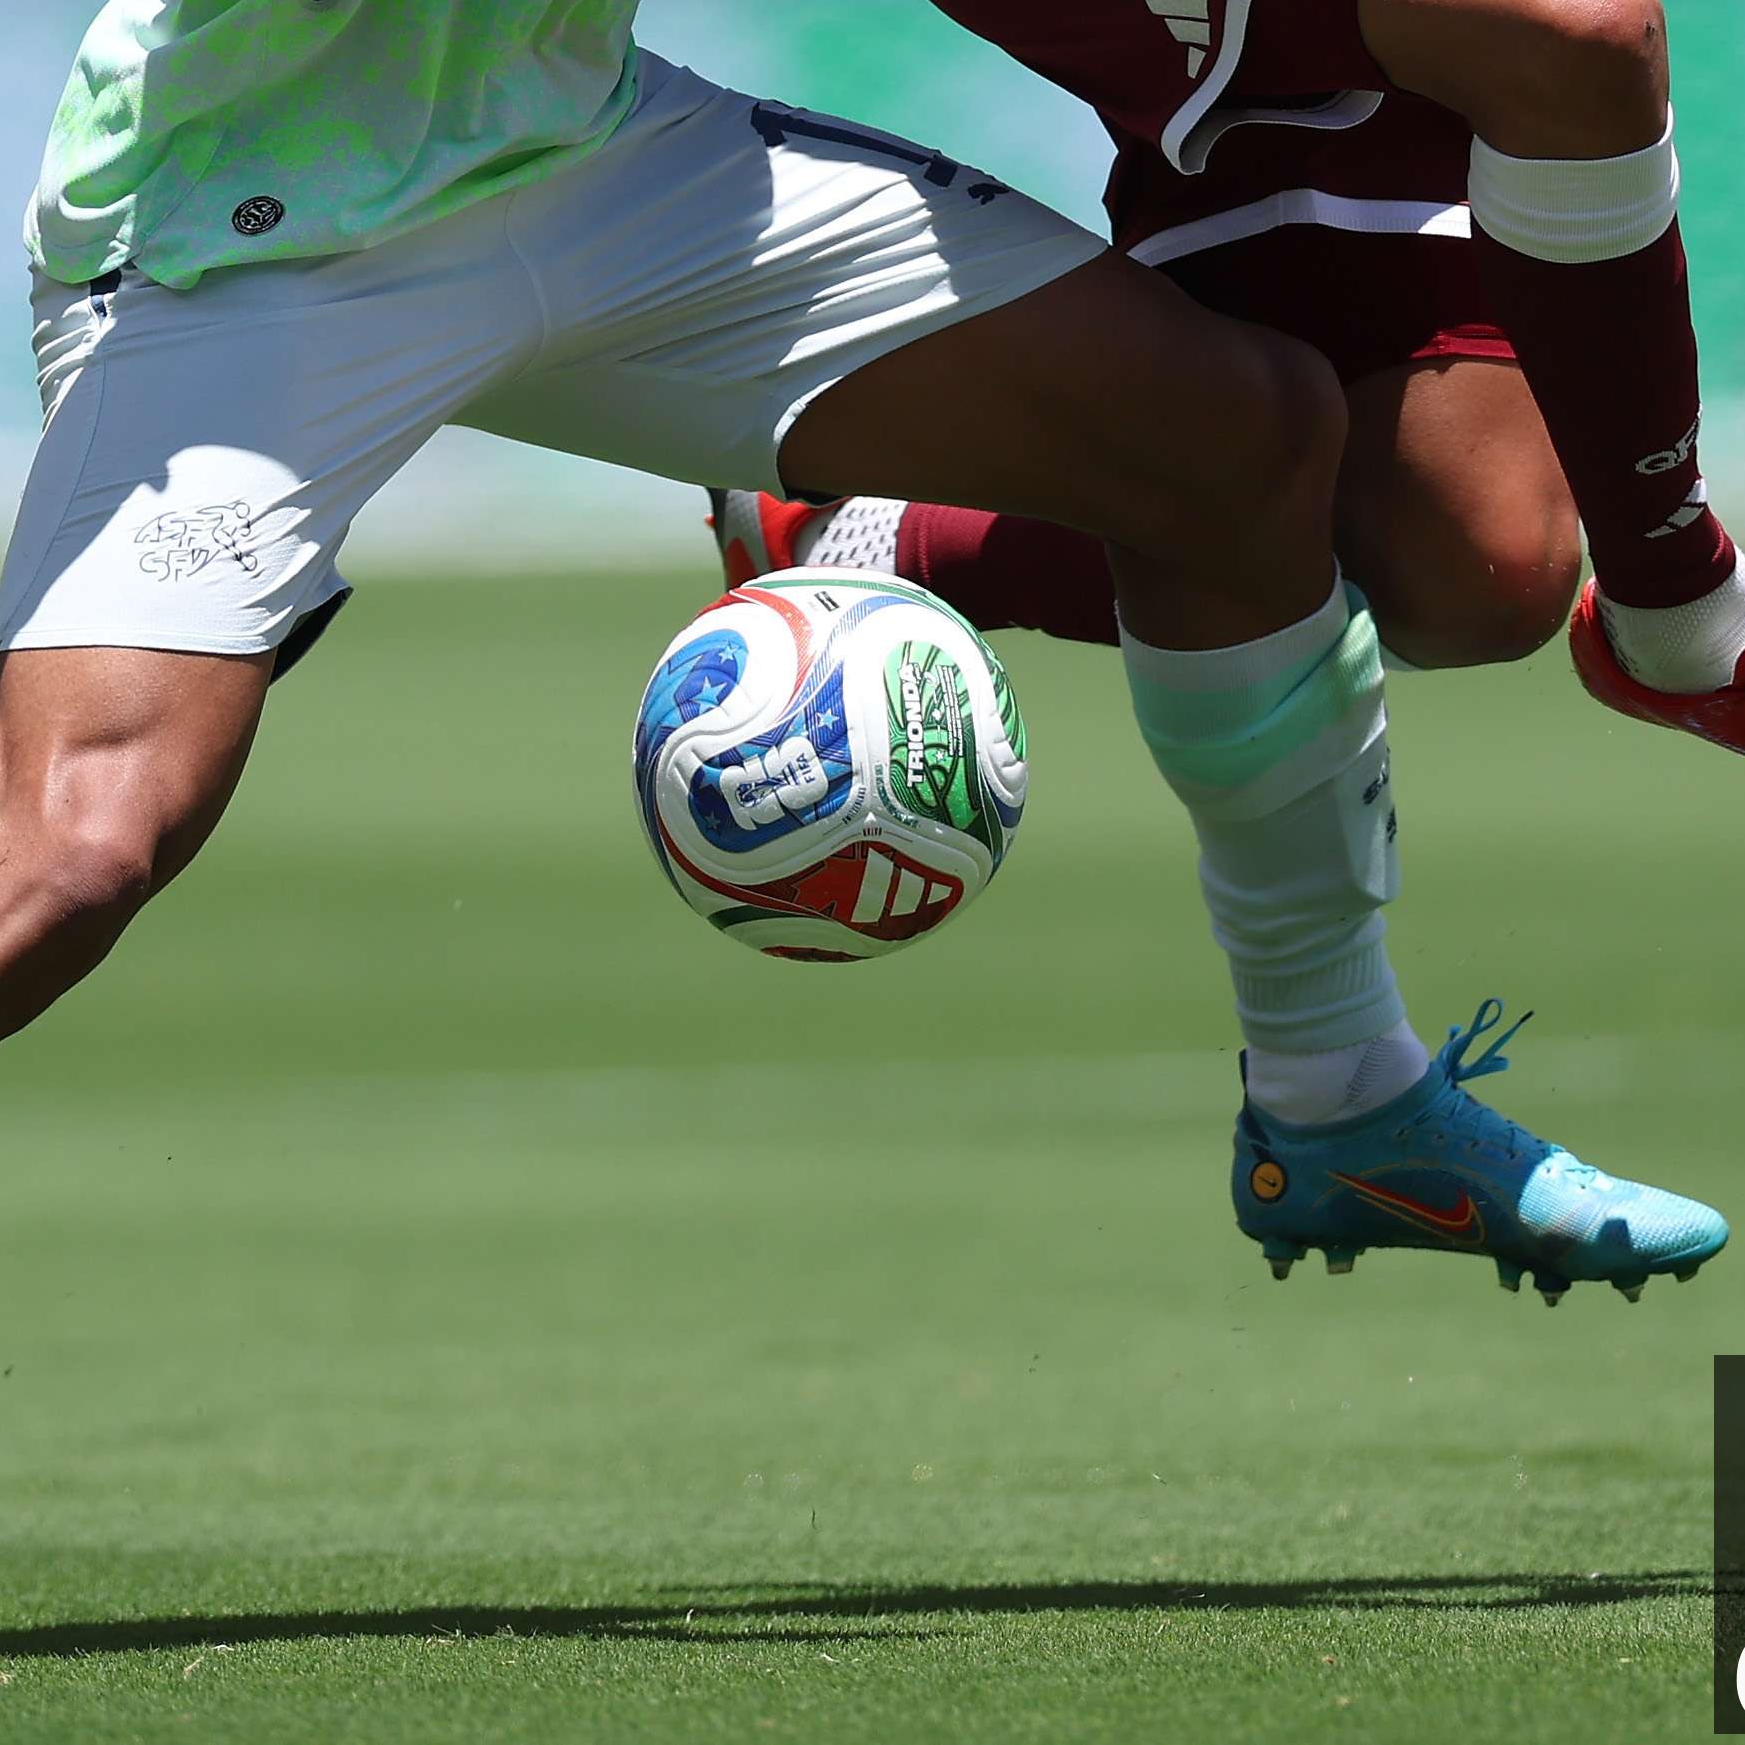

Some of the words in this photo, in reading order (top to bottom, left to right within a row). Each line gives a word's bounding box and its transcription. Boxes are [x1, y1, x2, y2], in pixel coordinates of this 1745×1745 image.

[1635, 418, 1698, 475] QF
[899, 662, 925, 789] TRIONDA
[796, 752, 816, 784] FIFA
